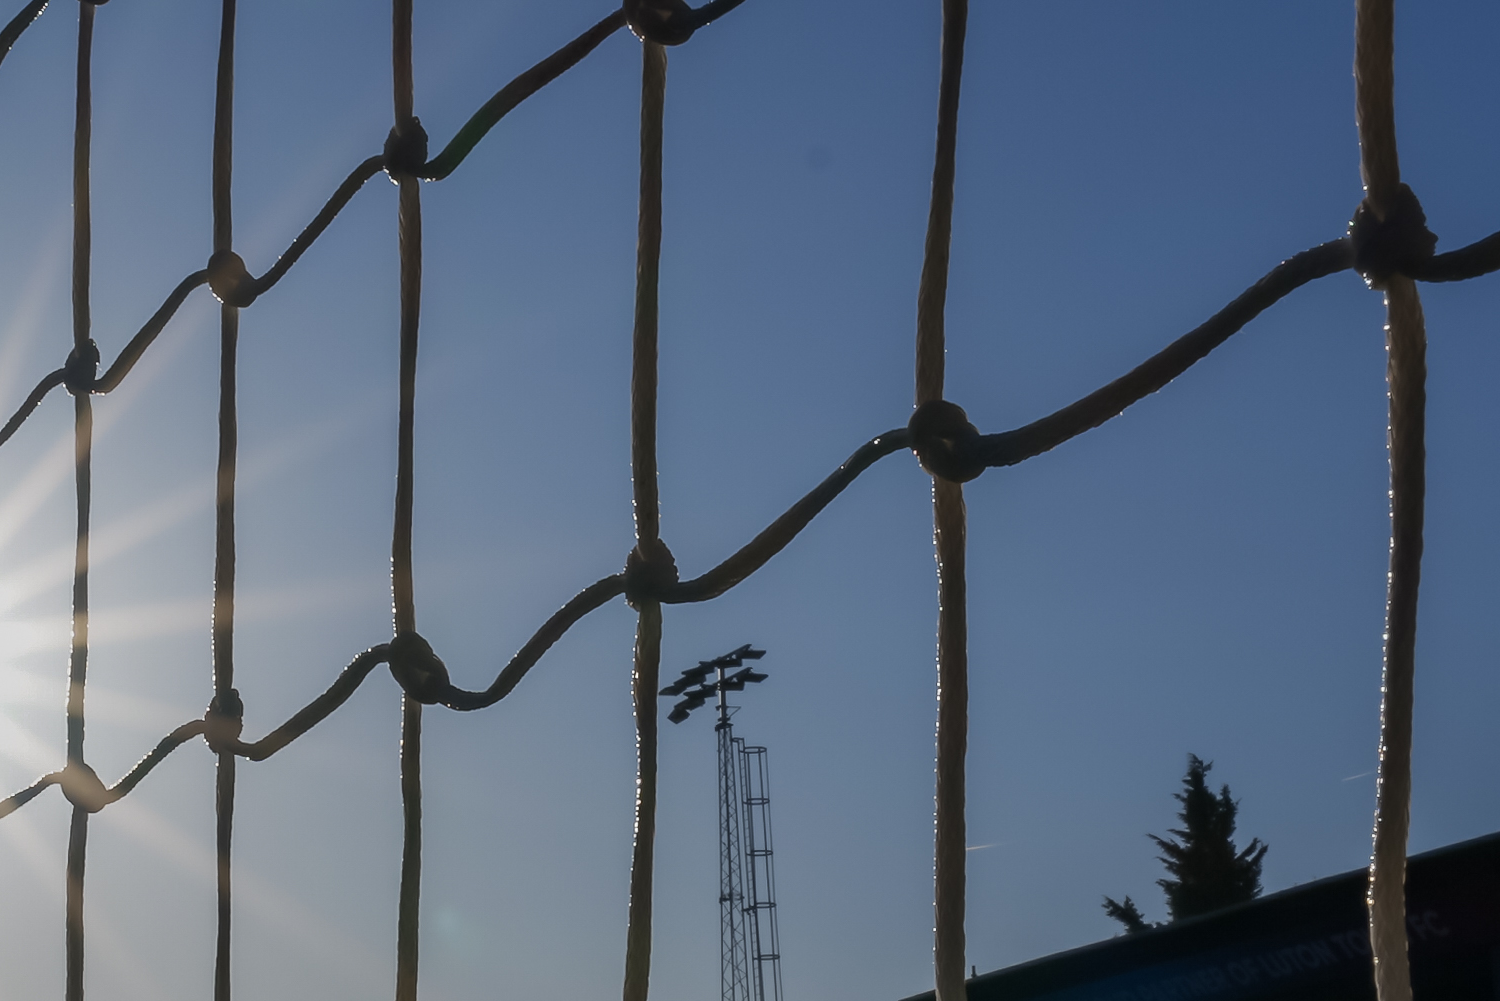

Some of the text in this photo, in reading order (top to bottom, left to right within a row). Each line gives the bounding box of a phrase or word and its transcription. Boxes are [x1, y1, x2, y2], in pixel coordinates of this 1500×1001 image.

[1223, 956, 1260, 987] OF
[1256, 939, 1340, 979] LUTON
[1411, 907, 1451, 943] FC
